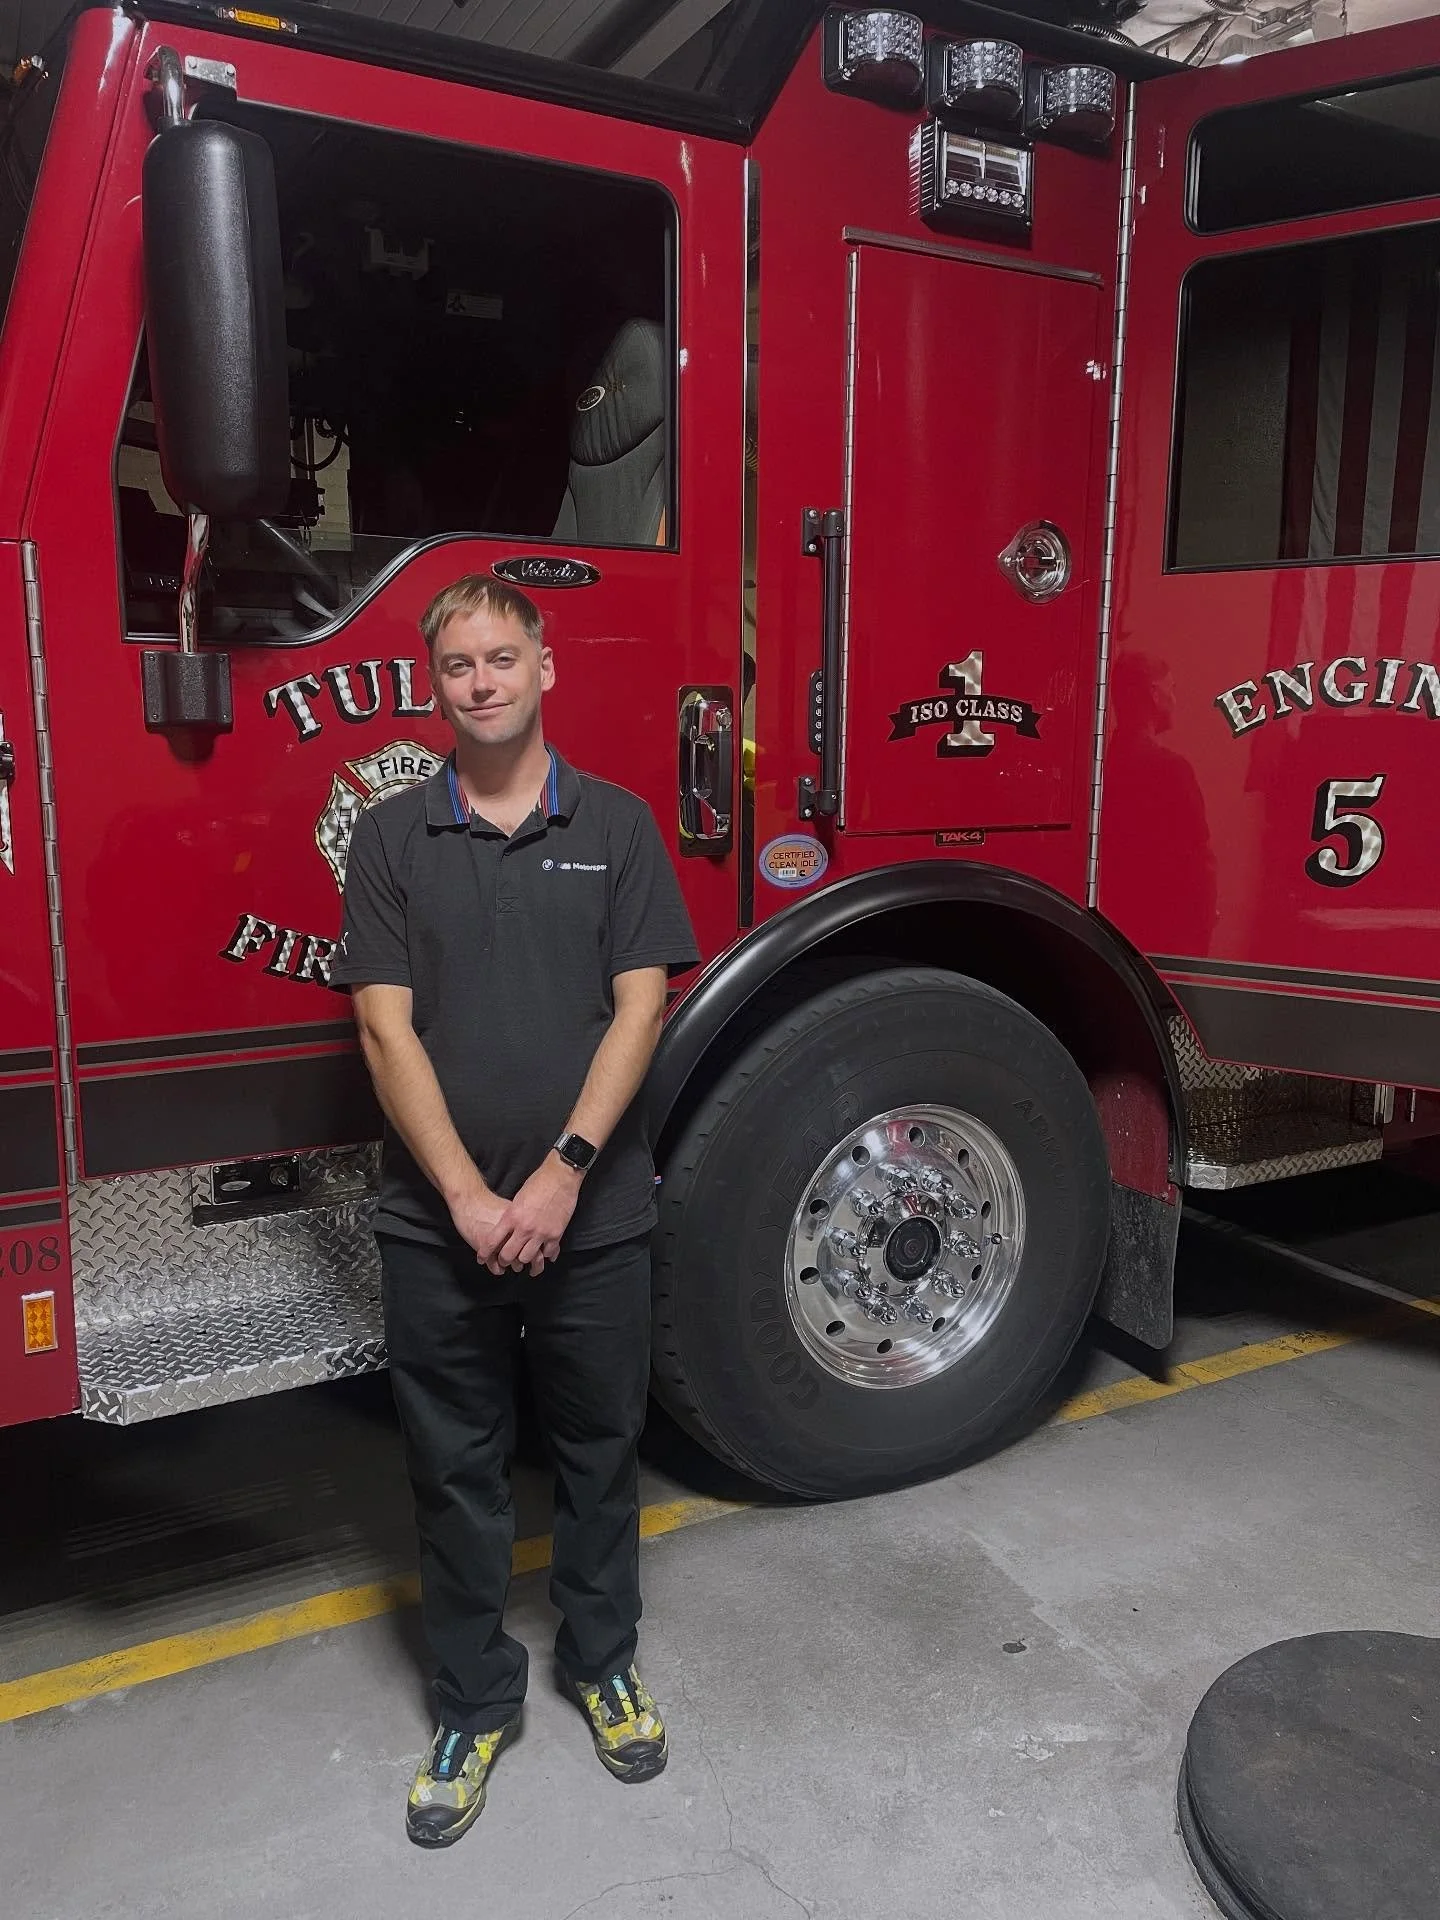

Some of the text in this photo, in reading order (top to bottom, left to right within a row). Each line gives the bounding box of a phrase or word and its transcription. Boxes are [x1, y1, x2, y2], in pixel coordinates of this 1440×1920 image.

[264, 658, 447, 743] TUL
[910, 699, 1023, 723] ISO CLASS
[938, 650, 995, 757] 1
[1214, 657, 1440, 737] ENGIN
[377, 756, 433, 778] FIRE
[939, 831, 981, 842] TAK-4
[1306, 773, 1387, 887] 5
[768, 860, 797, 869] CLEAN
[773, 850, 815, 860] CERTIFIED
[217, 913, 338, 986] FIR
[0, 1236, 61, 1276] 08
